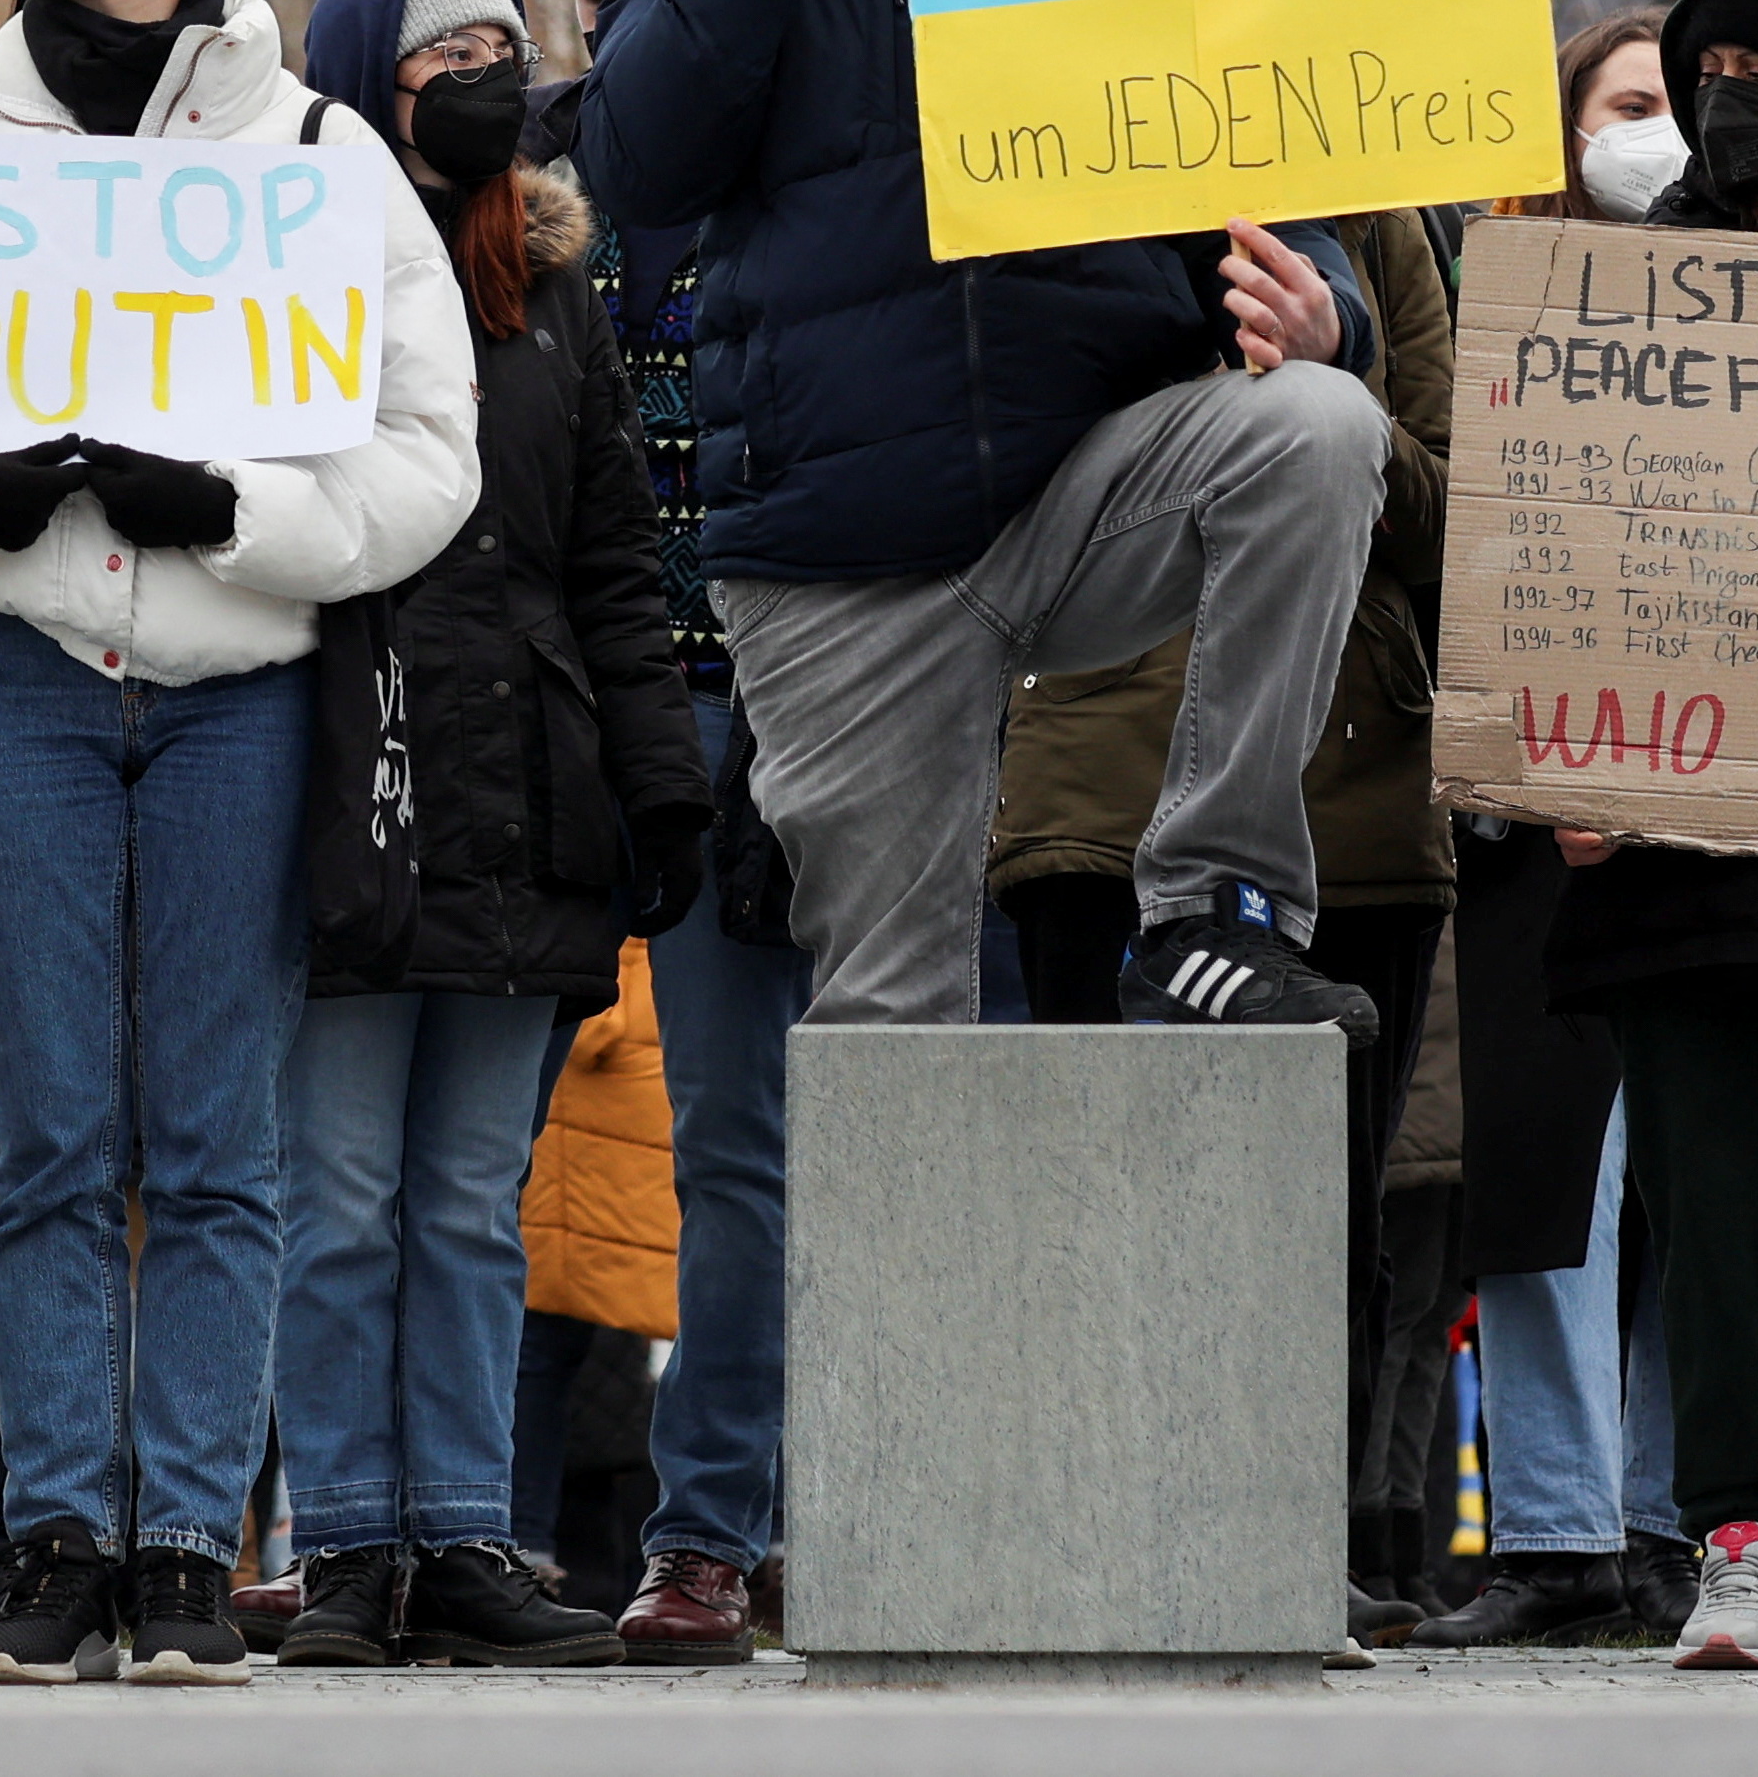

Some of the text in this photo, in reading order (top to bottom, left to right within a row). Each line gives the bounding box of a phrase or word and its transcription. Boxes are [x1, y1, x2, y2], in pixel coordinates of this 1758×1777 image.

[960, 50, 1515, 182] um JEDEN Preis
[1502, 438, 1613, 472] 1991-93
[1509, 511, 1566, 536] 1992
[1503, 585, 1595, 612] 1992-97
[1503, 623, 1597, 653] 1994-96
[1522, 686, 1725, 775] WHO
